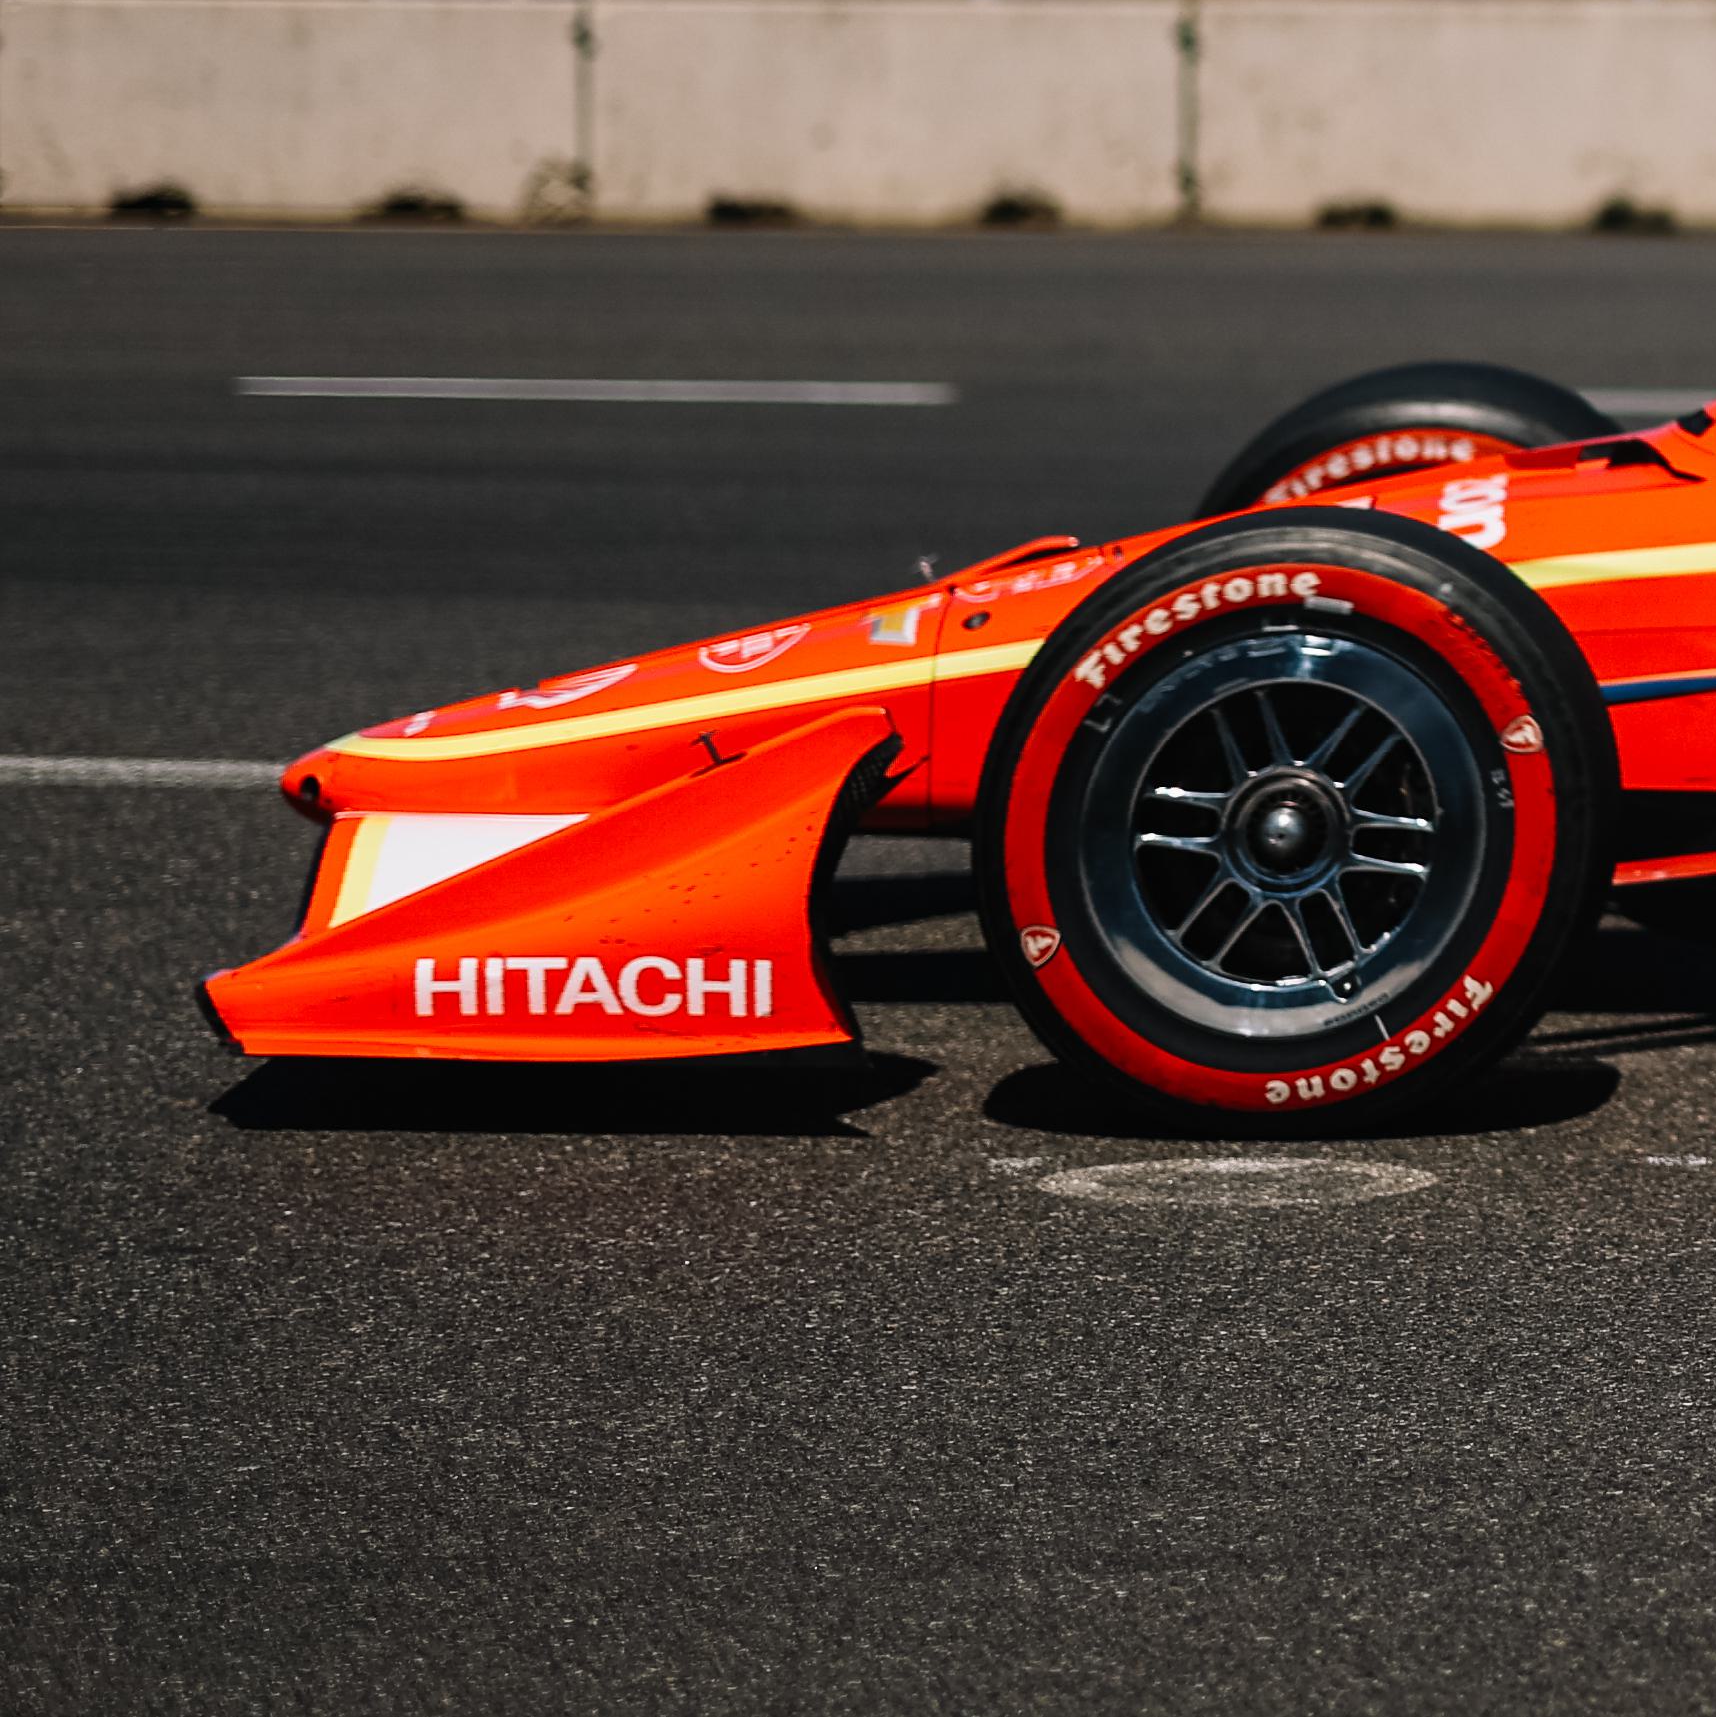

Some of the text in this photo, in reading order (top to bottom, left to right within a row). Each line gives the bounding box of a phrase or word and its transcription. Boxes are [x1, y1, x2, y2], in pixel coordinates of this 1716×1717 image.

[1264, 434, 1476, 505] Firestone
[1074, 571, 1322, 690] Firestone
[414, 955, 773, 1018] HITACHI
[1264, 974, 1495, 1105] Firestone
